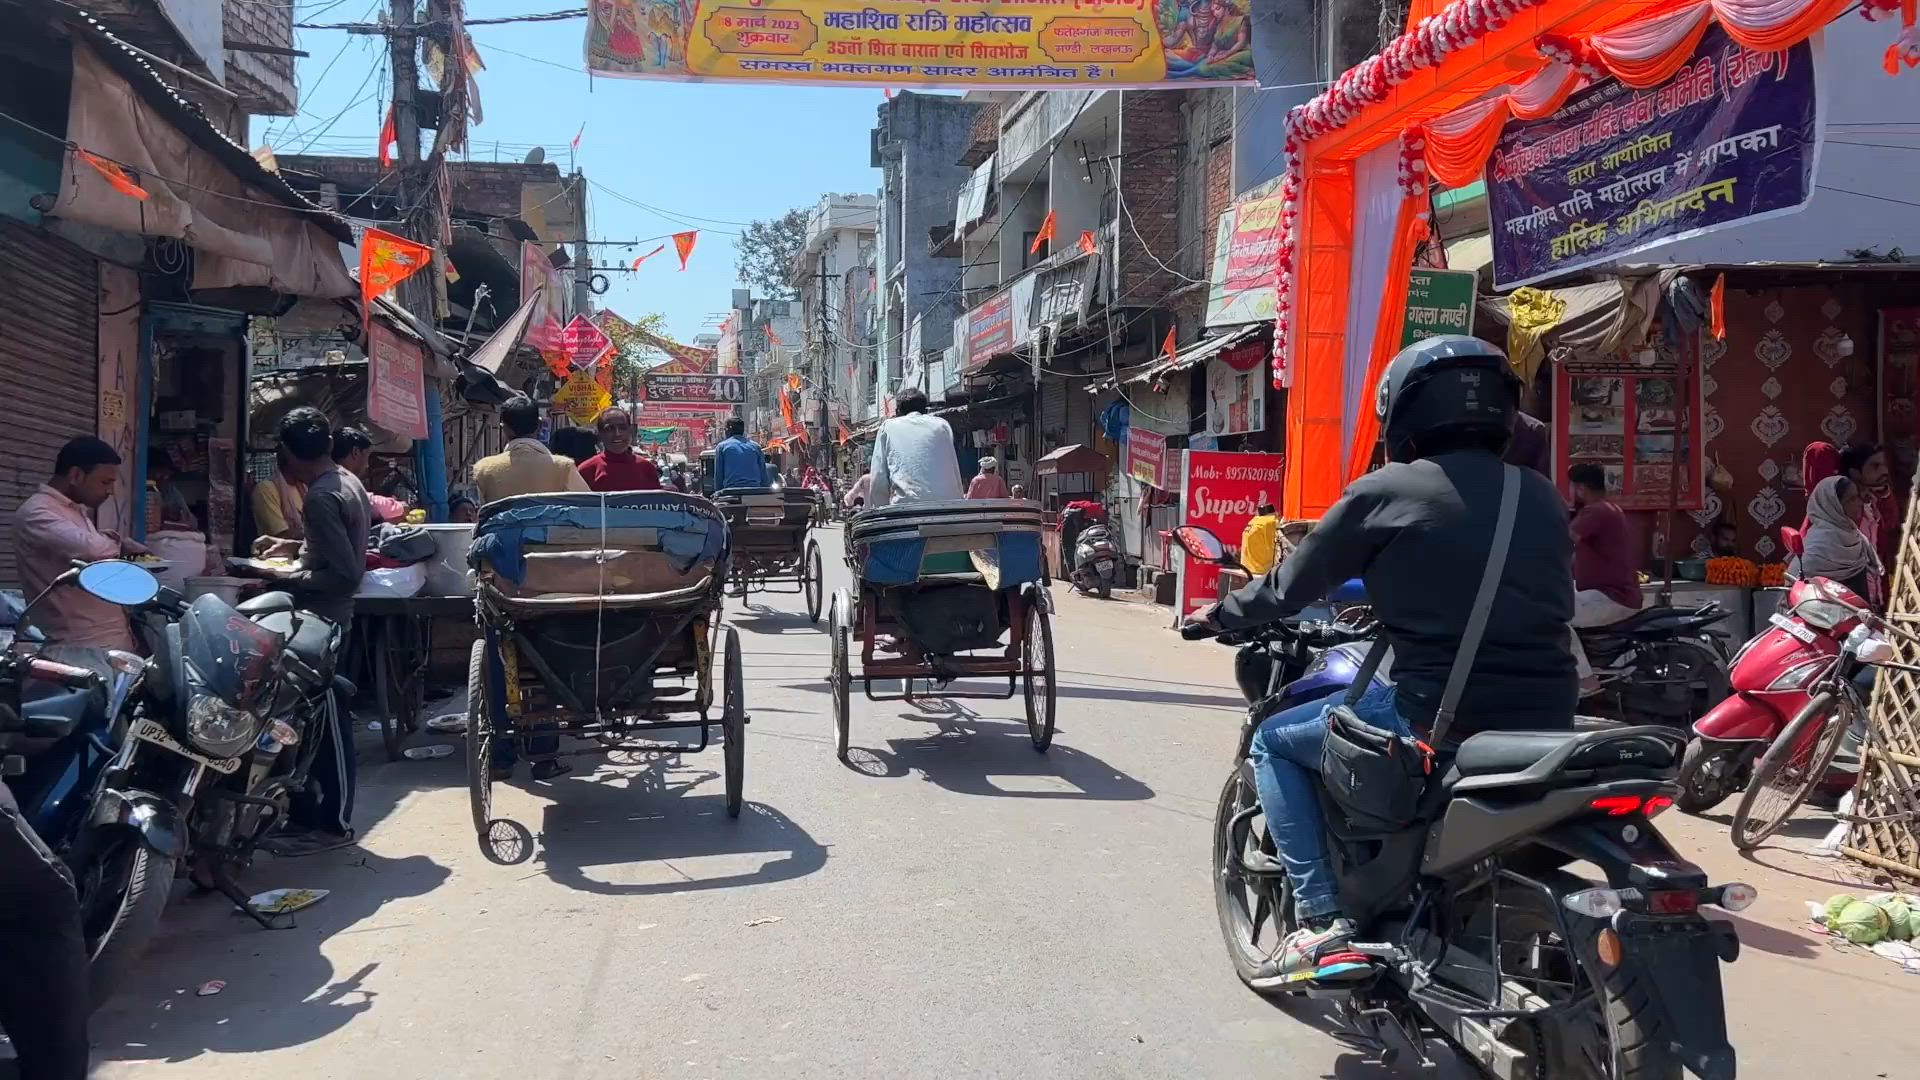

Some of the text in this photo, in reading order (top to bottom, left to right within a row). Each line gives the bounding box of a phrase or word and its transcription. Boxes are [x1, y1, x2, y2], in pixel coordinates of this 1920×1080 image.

[724, 16, 800, 30] 8 मार्च 2023
[824, 8, 1032, 34] महाशिव रात्रि महोत्सव
[1104, 27, 1134, 38] गल्ला
[736, 31, 790, 47] शुक्रवार
[868, 38, 897, 57] शिव
[902, 42, 939, 58] बारात
[945, 41, 964, 59] एवं
[970, 41, 1029, 60] शिवभोज
[1091, 43, 1133, 55] लखनऊ
[739, 60, 813, 72] समस्त
[822, 63, 913, 75] भक्तगण
[922, 66, 979, 77] सादर
[987, 64, 1079, 78] आमंत्रित
[1657, 56, 1716, 117] समिति
[1567, 131, 1673, 186] द्वारा आयोजित
[1505, 124, 1782, 235] महाशिव रात्रि महोत्सव में आपका
[1551, 177, 1737, 261] हार्दिक अभिनन्दन
[1440, 302, 1468, 328] मण्डी
